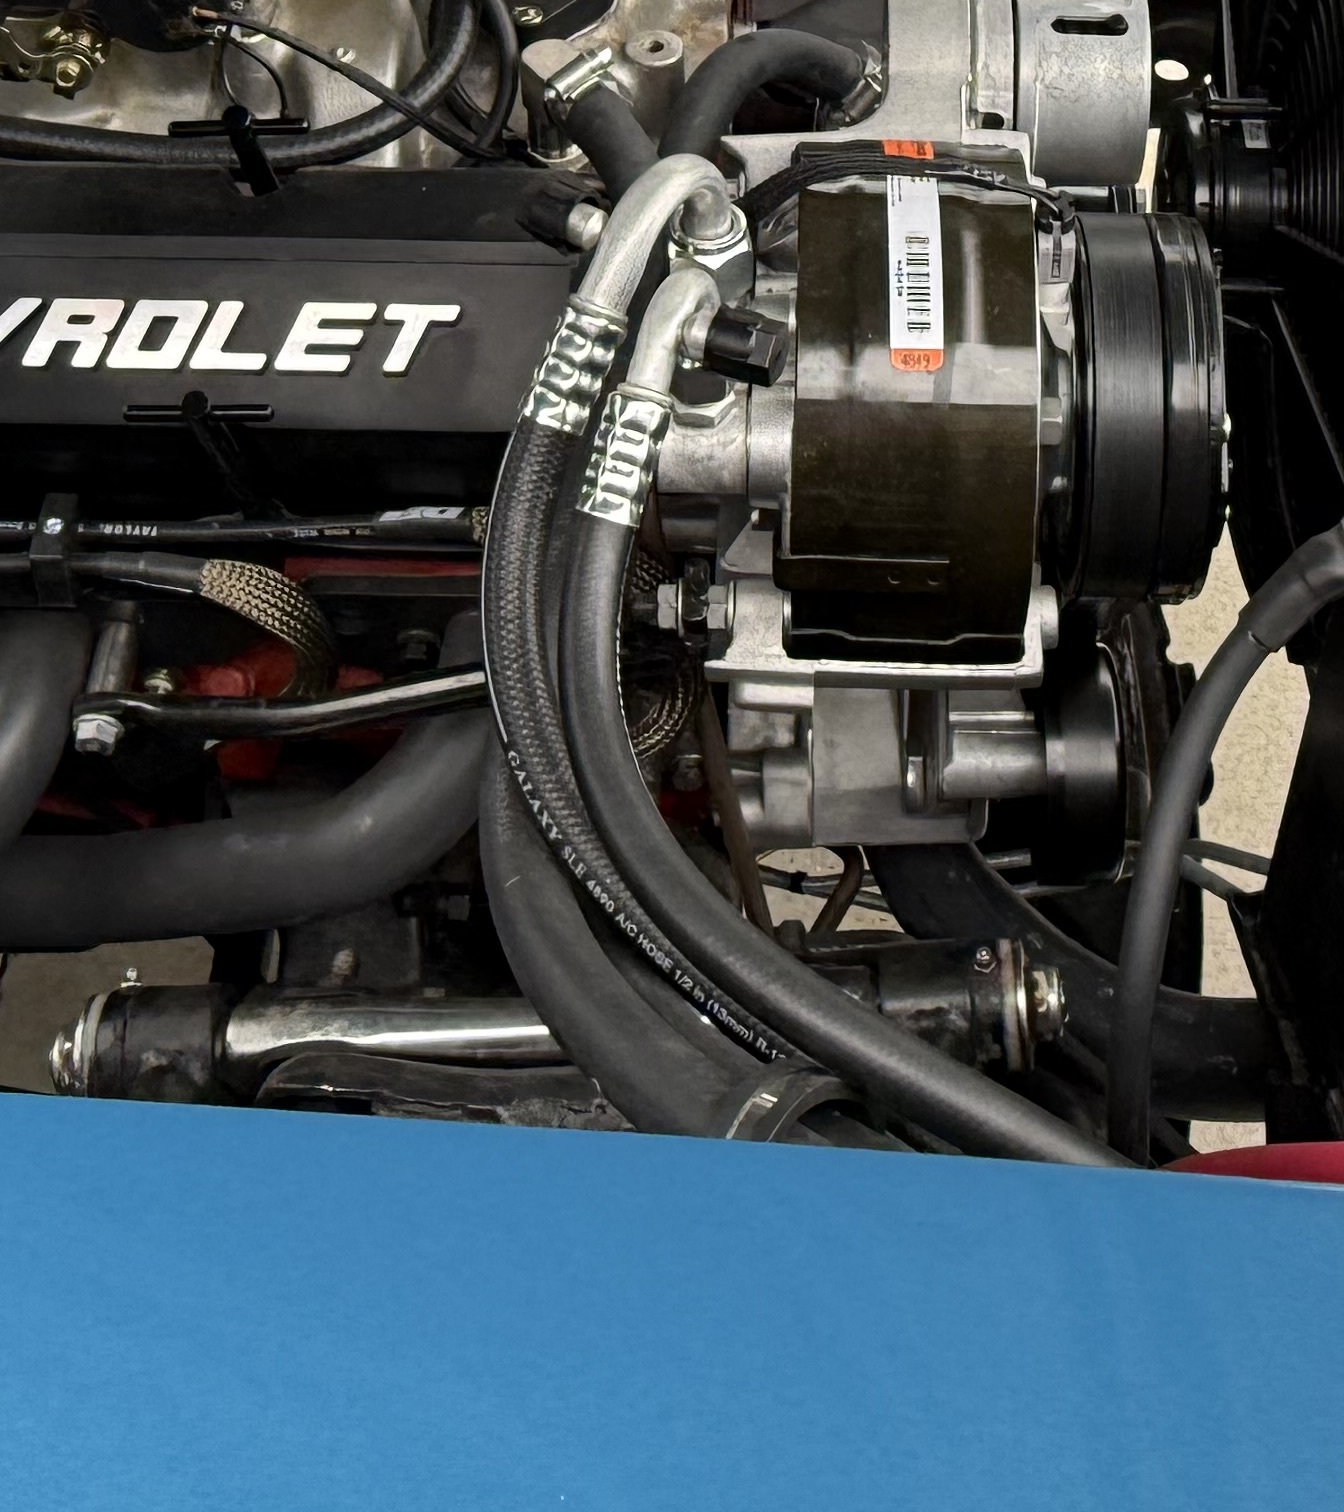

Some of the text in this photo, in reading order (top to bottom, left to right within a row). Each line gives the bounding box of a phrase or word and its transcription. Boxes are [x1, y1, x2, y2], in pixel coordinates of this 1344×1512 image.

[506, 749, 563, 841] GALAXY
[615, 910, 638, 937] A/C
[636, 933, 674, 976] HOSE
[673, 968, 694, 991] 1/2
[706, 998, 755, 1044] (13mm)
